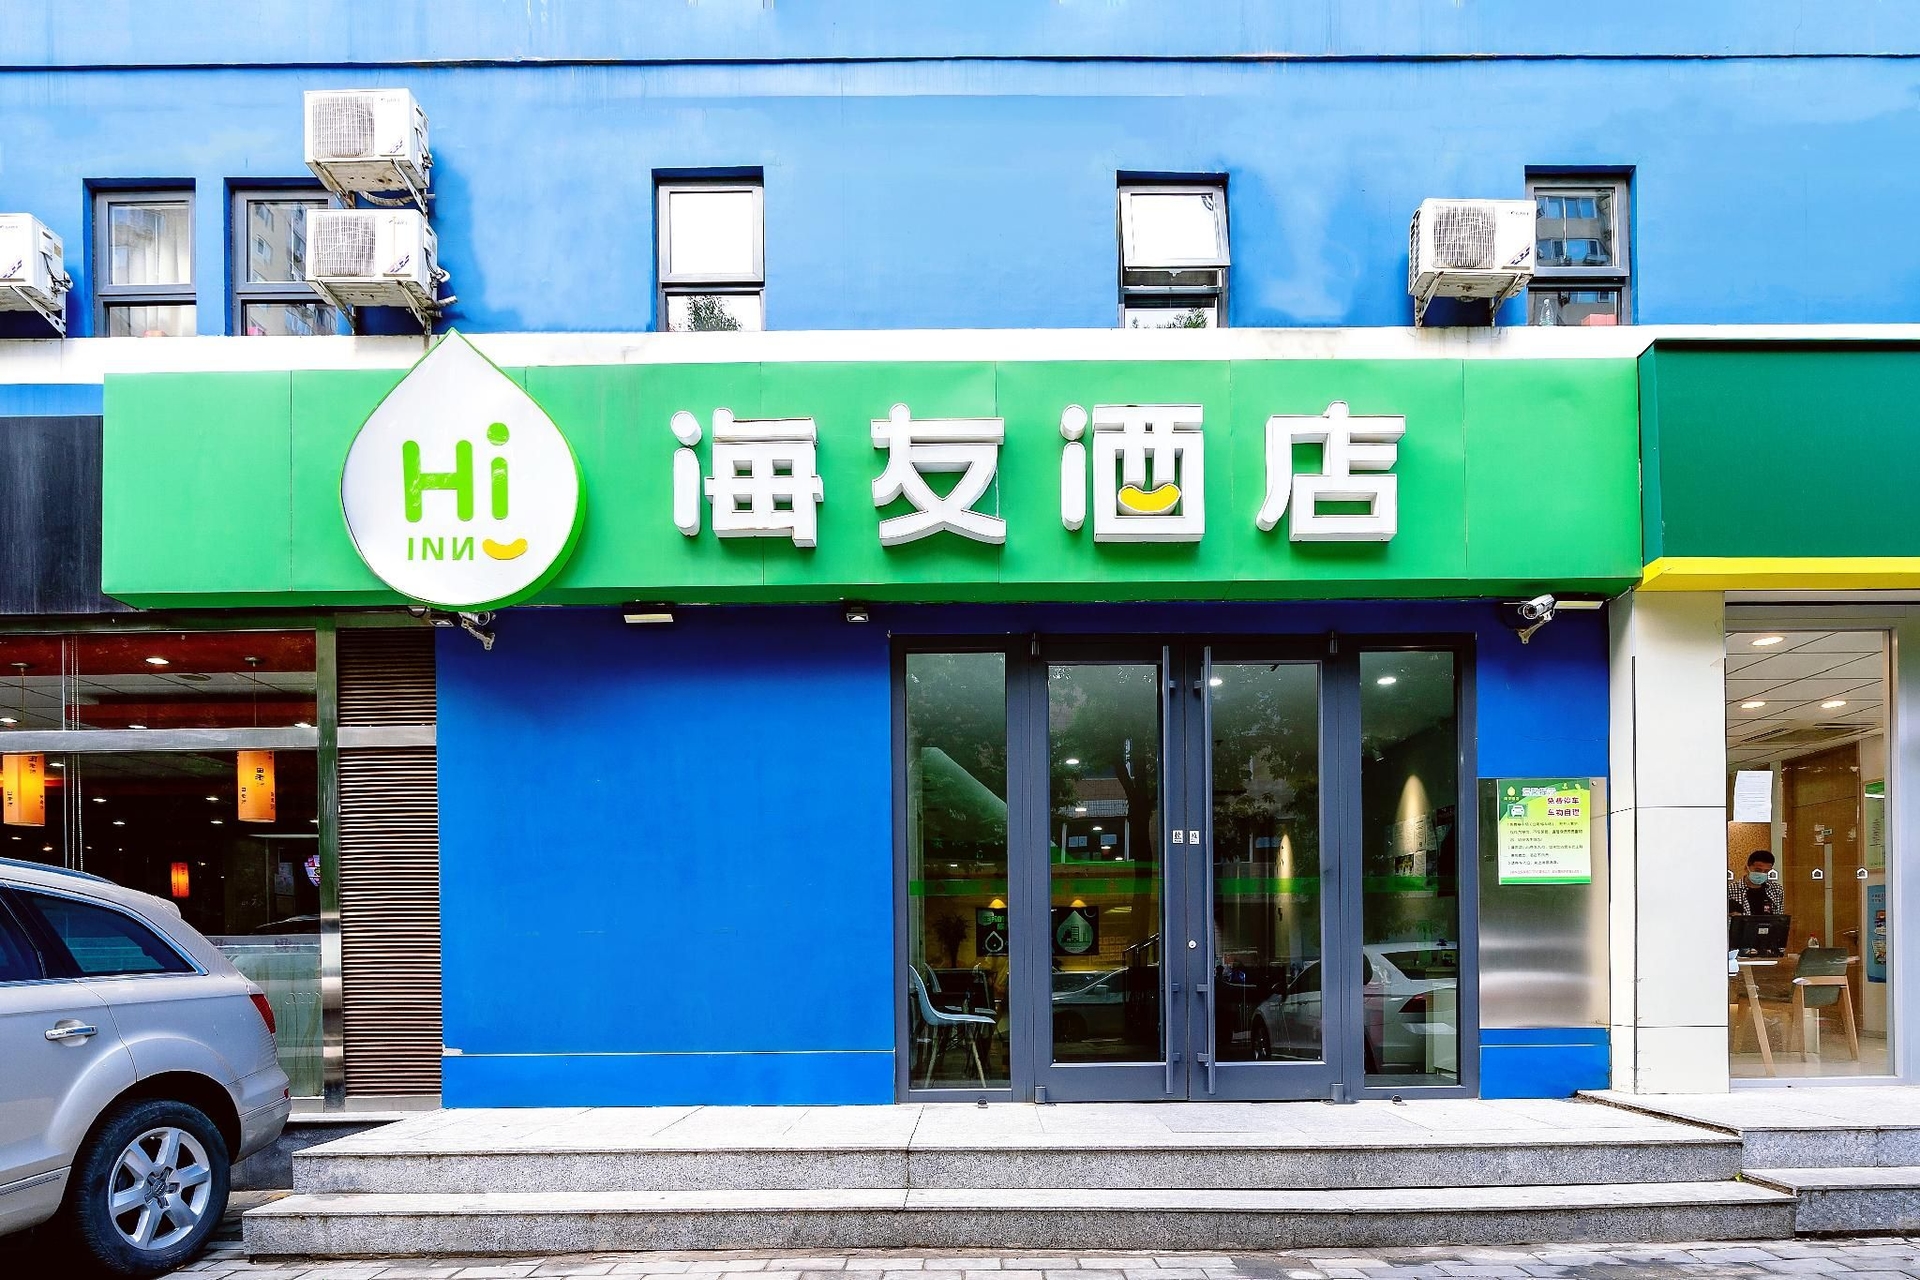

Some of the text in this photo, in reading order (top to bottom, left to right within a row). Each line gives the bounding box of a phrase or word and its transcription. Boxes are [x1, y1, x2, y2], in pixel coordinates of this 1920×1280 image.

[402, 422, 510, 523] Hi
[670, 400, 1407, 548] 海友酒店
